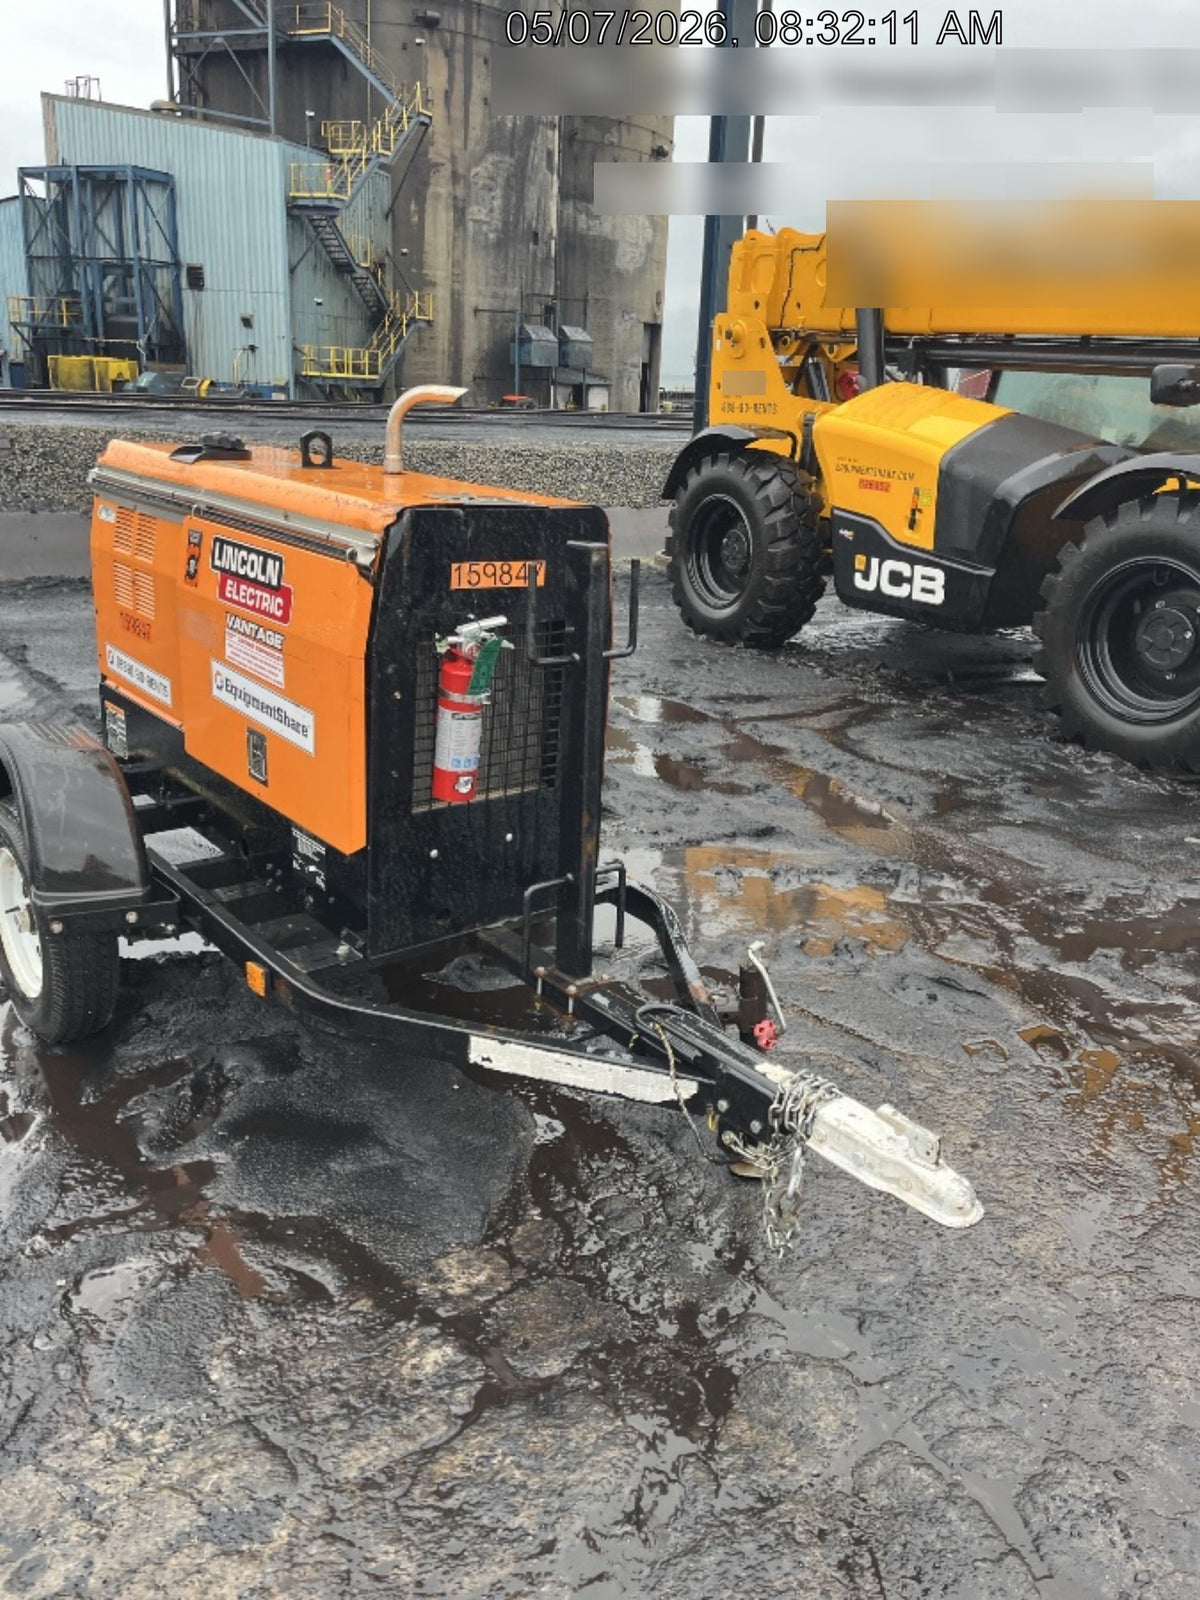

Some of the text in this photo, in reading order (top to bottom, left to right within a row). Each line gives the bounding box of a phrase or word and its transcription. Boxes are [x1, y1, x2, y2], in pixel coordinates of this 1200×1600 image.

[213, 541, 280, 586] LINCOLN
[854, 557, 945, 605] JCB
[225, 579, 284, 617] ELECTRIC
[226, 612, 285, 650] VANTAGE
[225, 677, 309, 738] EquipmentShare
